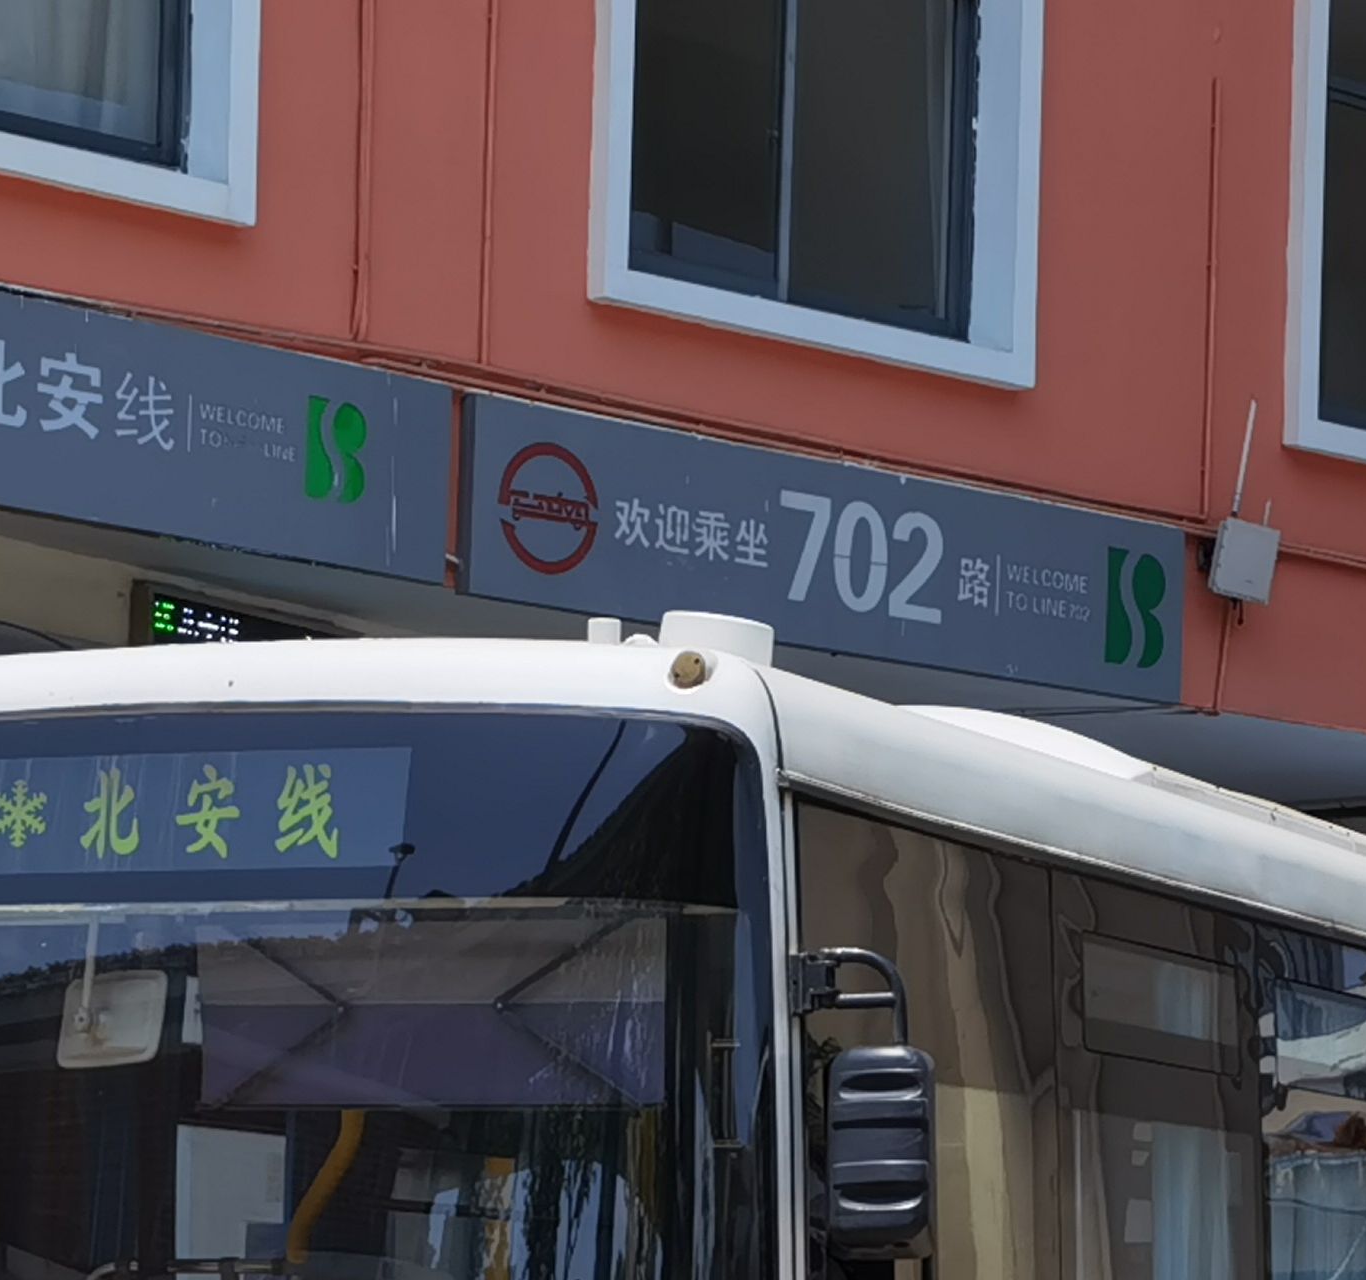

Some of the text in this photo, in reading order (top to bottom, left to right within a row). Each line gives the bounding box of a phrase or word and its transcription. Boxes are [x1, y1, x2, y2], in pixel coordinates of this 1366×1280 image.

[199, 403, 284, 434] WELCOME
[615, 489, 991, 624] 欢迎乘坐 702 路
[1007, 563, 1088, 594] WELCOME
[1007, 591, 1028, 612] TO
[79, 763, 338, 859] 北安线
